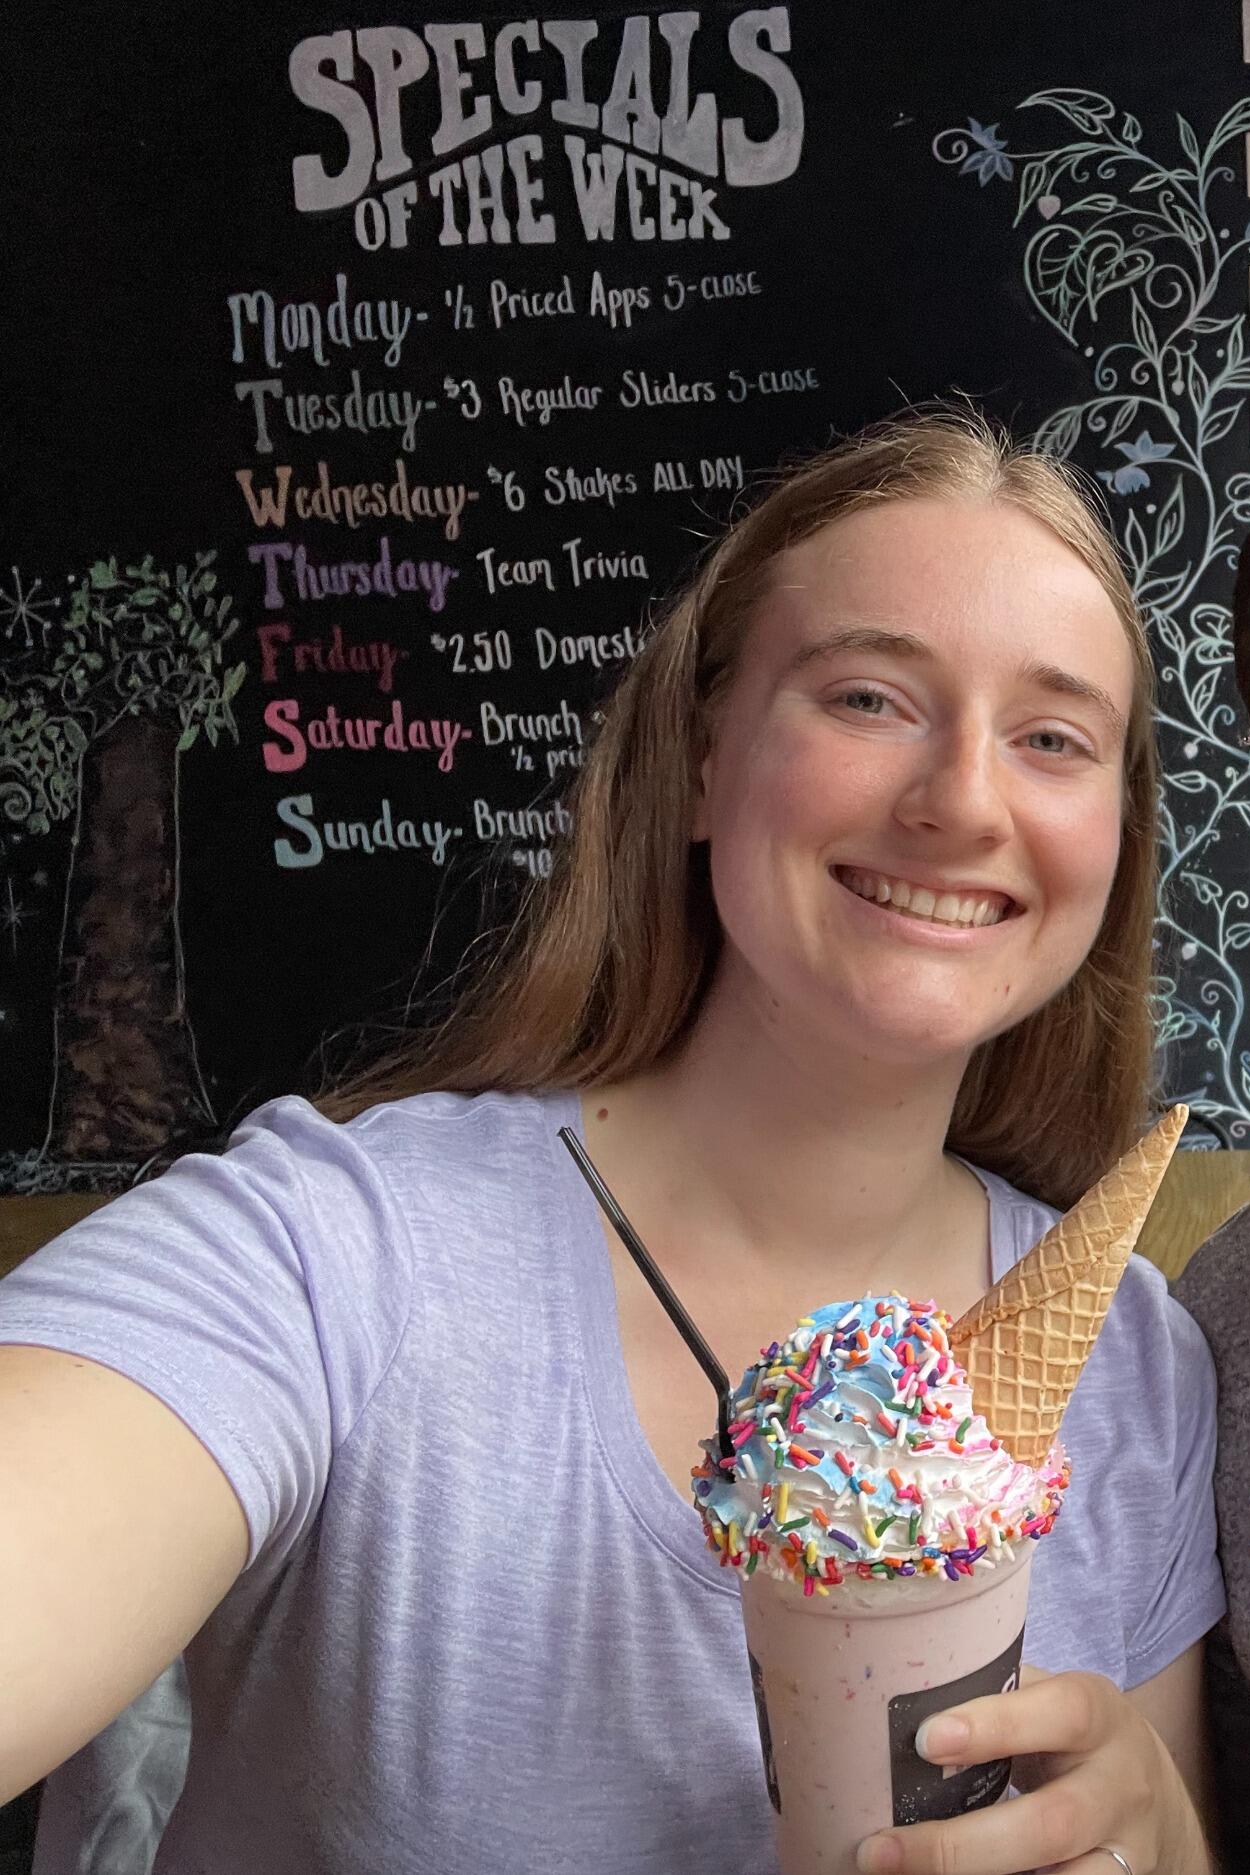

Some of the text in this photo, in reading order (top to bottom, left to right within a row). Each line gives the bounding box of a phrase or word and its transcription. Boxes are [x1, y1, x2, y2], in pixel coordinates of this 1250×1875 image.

[289, 6, 804, 211] SPECIALS
[355, 134, 730, 250] OF THE WEEK
[490, 280, 576, 329] Priced
[590, 271, 651, 328] Apps
[444, 376, 481, 419] $3
[498, 376, 602, 427] Regular
[620, 370, 716, 407] Sliders
[487, 464, 525, 512] $6
[544, 466, 638, 509] Shakes
[654, 462, 694, 493] ALL
[699, 455, 744, 491] DAY
[476, 548, 555, 594] Team
[562, 537, 649, 588] Trivia
[430, 629, 512, 673] $2.50
[480, 700, 583, 745] Brunch
[473, 798, 573, 841] Brunch
